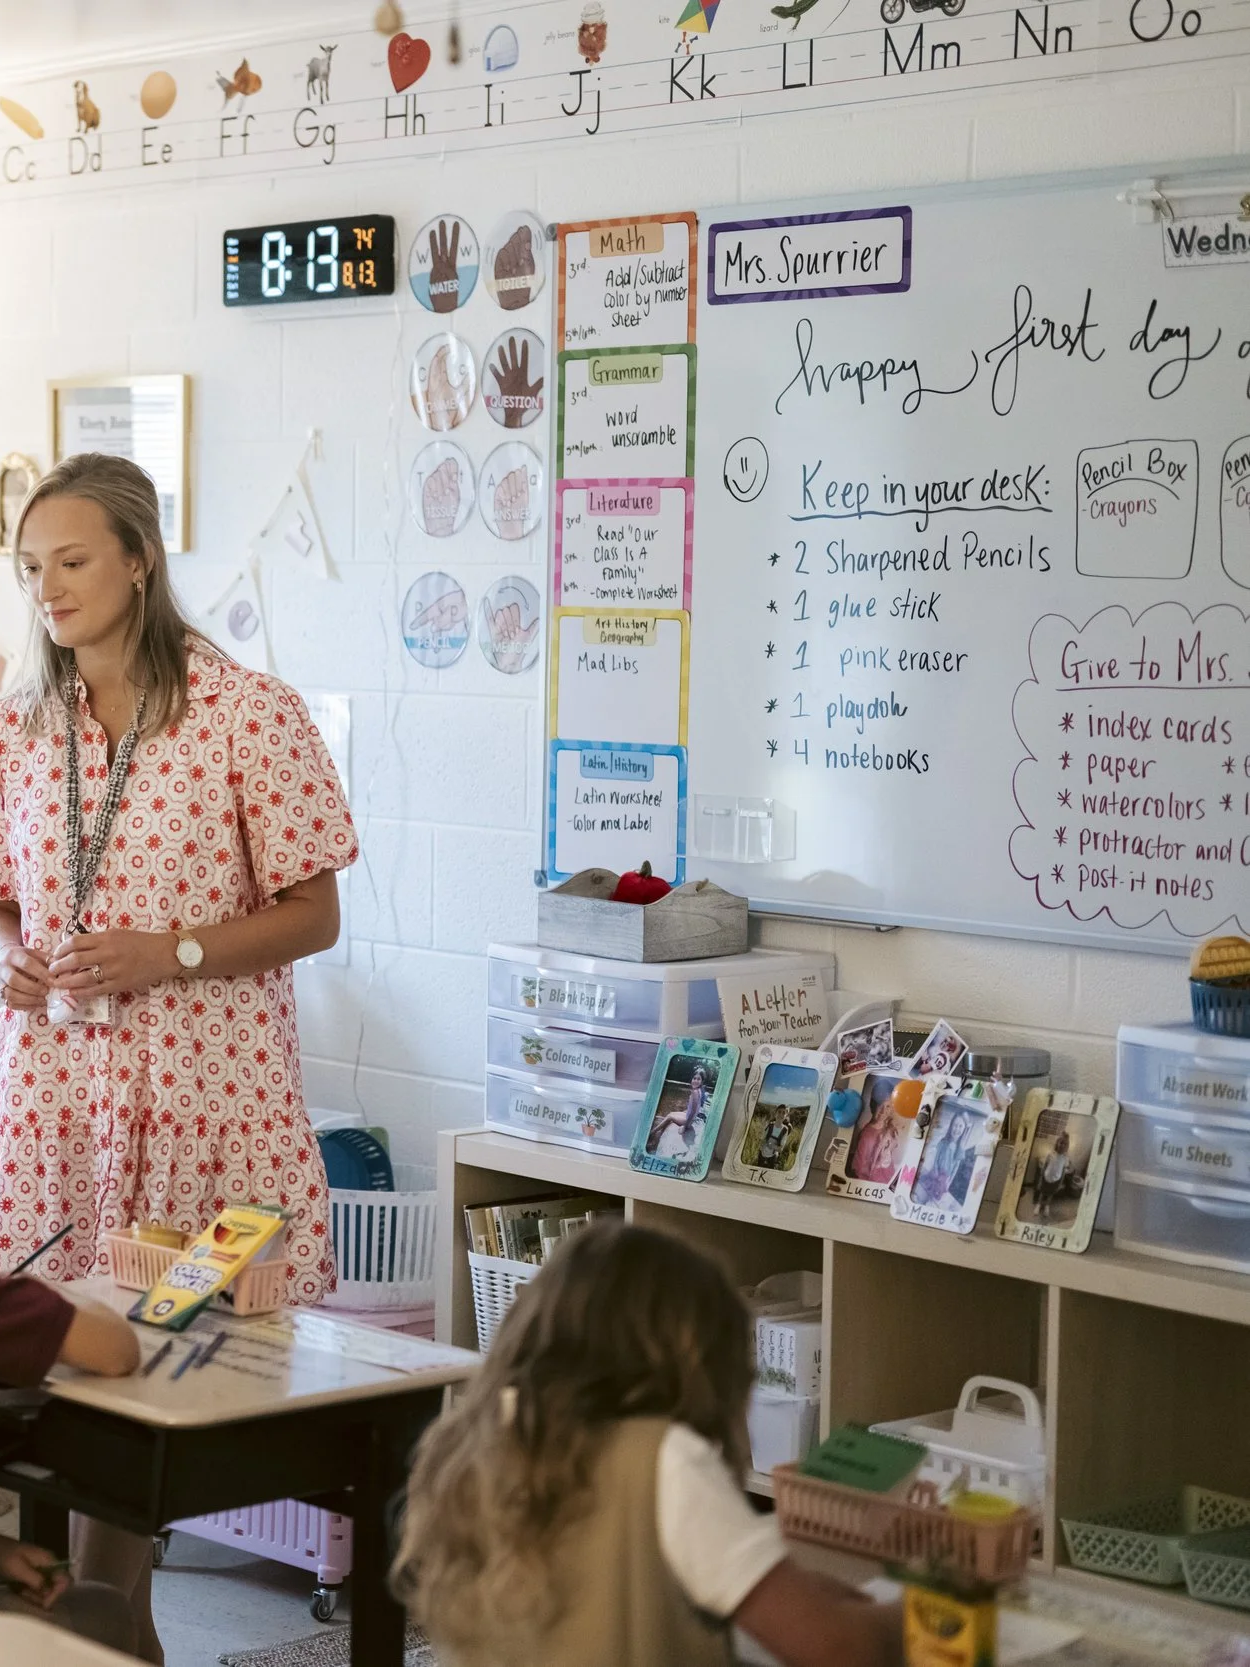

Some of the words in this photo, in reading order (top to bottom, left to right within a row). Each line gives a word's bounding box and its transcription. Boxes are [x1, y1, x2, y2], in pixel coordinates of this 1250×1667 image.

[759, 22, 778, 33] lizard
[68, 133, 102, 175] Dd
[142, 126, 173, 165] Ee
[220, 114, 255, 157] Ff
[293, 107, 336, 165] Gg
[385, 93, 426, 139] Hh
[561, 69, 601, 135] Jj
[670, 54, 715, 103] Kk
[884, 22, 961, 76] Mm
[1014, 5, 1072, 59] Nn
[1130, 0, 1202, 42] Oo
[600, 225, 645, 253] Math
[1167, 222, 1250, 258] Wedn
[262, 226, 339, 298] 8:13
[605, 257, 685, 289] Add/Subtract
[724, 241, 772, 287] Mrs.
[777, 235, 887, 284] Spurrier
[429, 280, 460, 296] WATER
[498, 276, 530, 291] TOILET
[635, 290, 650, 317] by
[654, 286, 687, 304] number
[776, 318, 978, 415] happy
[985, 285, 1105, 416] first
[1130, 298, 1221, 400] day
[592, 360, 660, 383] Grammar
[490, 395, 540, 409] QUESTION
[611, 424, 676, 447] unscramble
[1082, 453, 1132, 491] Pencil
[1147, 447, 1187, 485] Box
[590, 491, 653, 512] Literature
[802, 460, 869, 519] Keep
[883, 474, 906, 506] in
[915, 478, 974, 532] your
[597, 525, 624, 541] Read
[593, 546, 619, 563] Class
[639, 546, 647, 560] A
[794, 540, 810, 574] 2
[827, 535, 951, 581] Sharpened
[962, 530, 1051, 572] Pencils
[793, 589, 810, 621] 1
[828, 593, 877, 628] glue
[889, 588, 941, 622] stick
[595, 618, 611, 629] Art
[417, 636, 451, 649] PENCIL
[600, 631, 644, 645] Geography
[577, 651, 607, 673] Mad
[612, 654, 639, 674] Libs
[792, 640, 810, 670] 1
[840, 645, 891, 677] pink
[897, 649, 968, 672] eraser
[1061, 640, 1120, 684] Give
[1129, 635, 1160, 681] to
[1177, 630, 1234, 684] Mrs.
[790, 691, 810, 717] 1
[826, 691, 908, 735] playdoh
[1088, 704, 1152, 742] index
[1163, 716, 1232, 745] cards
[794, 738, 809, 765] 4
[825, 743, 929, 774] notebooks
[1087, 753, 1157, 785] paper
[575, 787, 606, 805] Latin
[1082, 791, 1206, 821] watercolors
[600, 817, 621, 830] and
[623, 814, 652, 833] Label
[1079, 828, 1186, 860] protractor
[1195, 838, 1232, 863] and
[1156, 873, 1214, 901] notes
[549, 987, 578, 1005] Blank
[741, 993, 752, 1015] A
[754, 984, 807, 1012] Letter
[738, 1018, 759, 1038] from
[780, 1008, 822, 1030] Teacher
[545, 1048, 581, 1066] Colored
[583, 1056, 611, 1073] Paper
[1163, 1076, 1210, 1097] Absent
[1213, 1082, 1248, 1101] Work
[514, 1099, 539, 1116] Lined
[542, 1106, 571, 1124] Paper
[640, 1156, 677, 1175] Eliza
[1160, 1140, 1183, 1159] Fun
[1186, 1146, 1234, 1168] Sheets
[846, 1181, 886, 1200] Lucas
[909, 1205, 945, 1225] Macie
[1021, 1226, 1056, 1246] Riley
